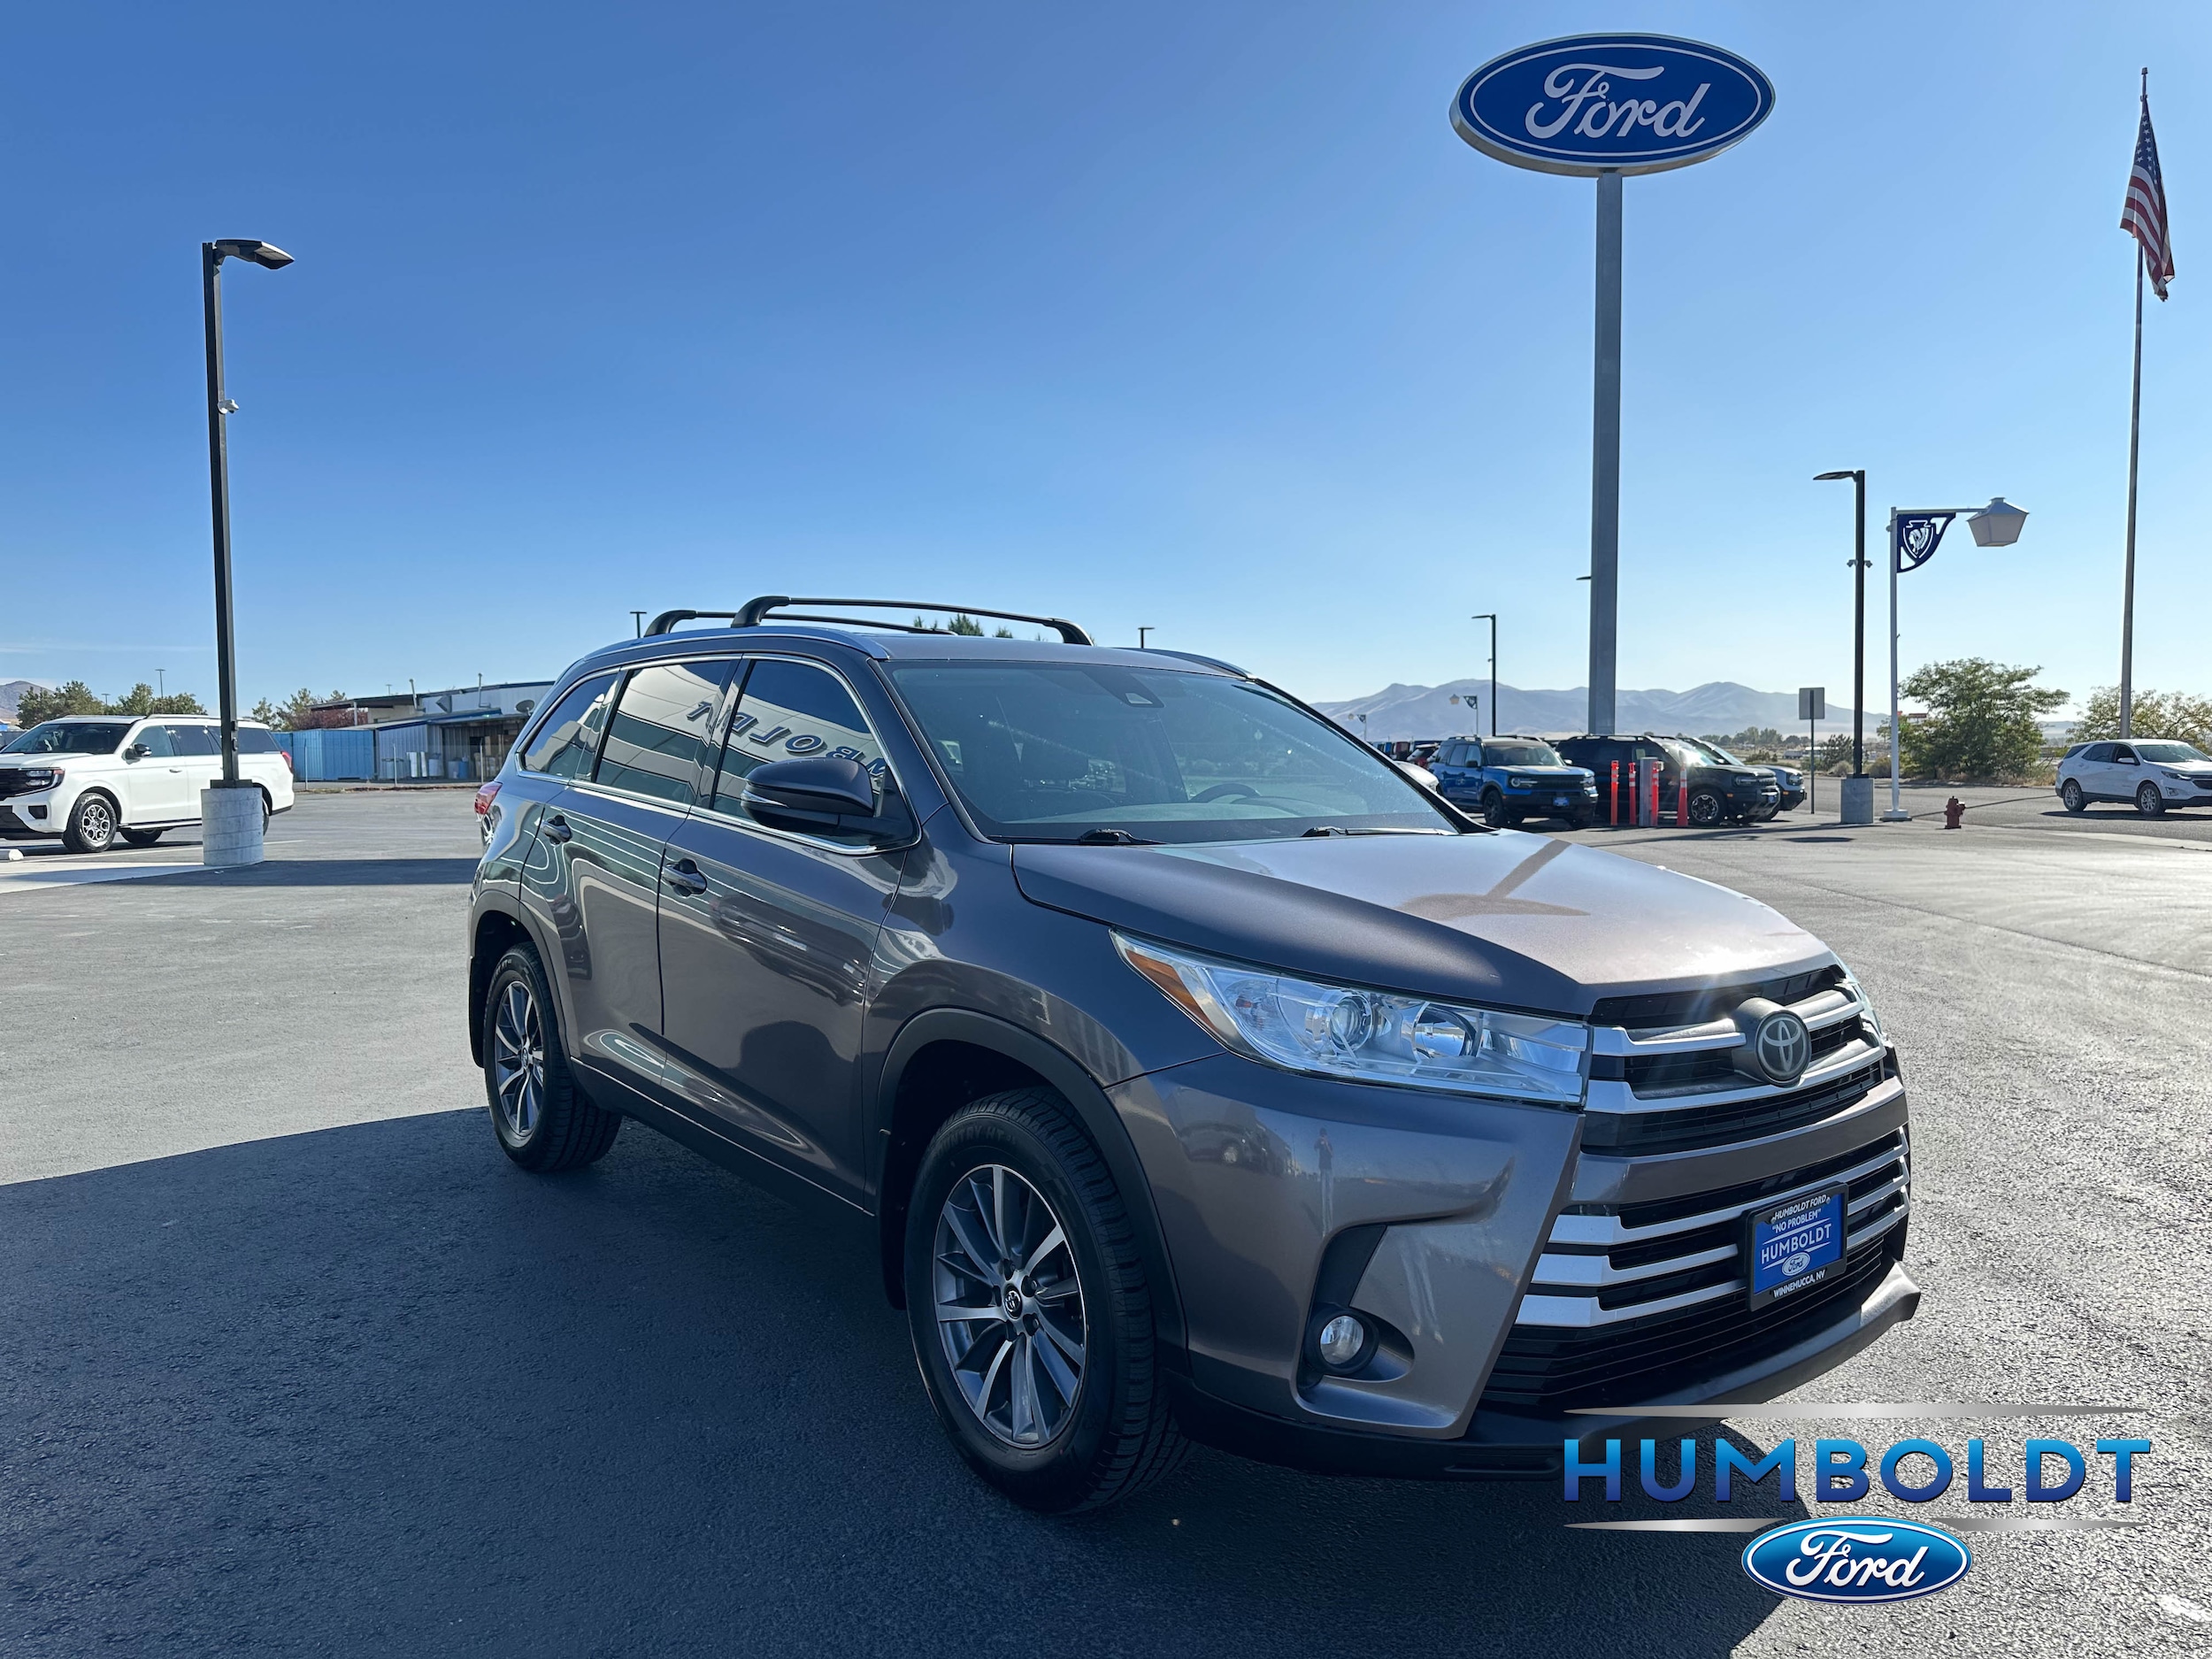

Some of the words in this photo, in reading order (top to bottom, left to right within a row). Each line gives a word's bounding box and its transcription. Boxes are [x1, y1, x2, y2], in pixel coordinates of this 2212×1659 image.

[1525, 63, 1711, 139] Ford
[1774, 1199, 1810, 1220] HUMBOLDT
[1809, 1194, 1827, 1207] FORD
[1761, 1223, 1832, 1264] HUMBOLDT
[1788, 1256, 1805, 1272] Ford
